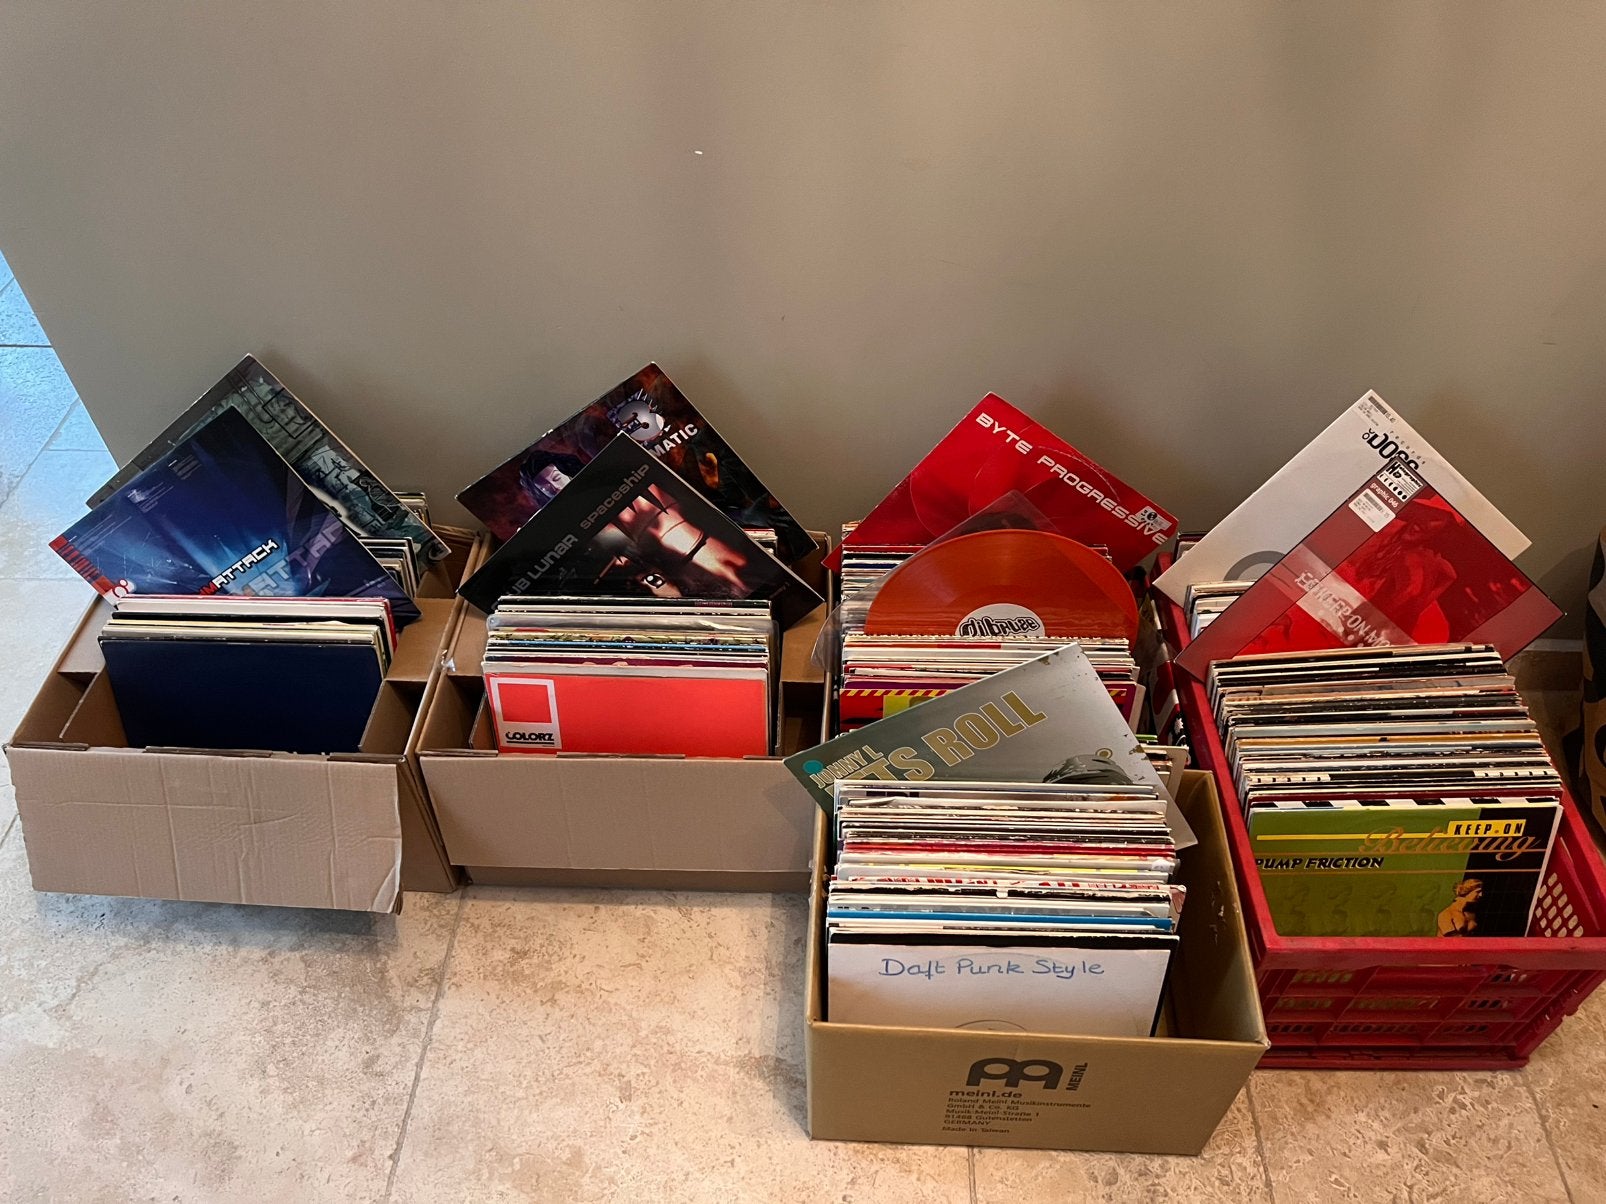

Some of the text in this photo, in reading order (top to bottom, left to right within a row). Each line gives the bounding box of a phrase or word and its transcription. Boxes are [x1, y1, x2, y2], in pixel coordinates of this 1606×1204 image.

[1389, 430, 1426, 465] records
[975, 412, 1033, 455] BYTE
[1037, 455, 1168, 545] PROGRESSIVE
[1370, 482, 1389, 504] graphic
[505, 731, 555, 742] COLORZ
[921, 690, 1048, 767] ROLL
[809, 745, 884, 789] JONNY L
[1454, 823, 1523, 835] KEEP ON
[1255, 856, 1385, 870] PUMP FRICTION
[879, 958, 1105, 980] Daft Punk Style
[1066, 1062, 1089, 1092] MEINL
[949, 1090, 1023, 1098] meinl.de
